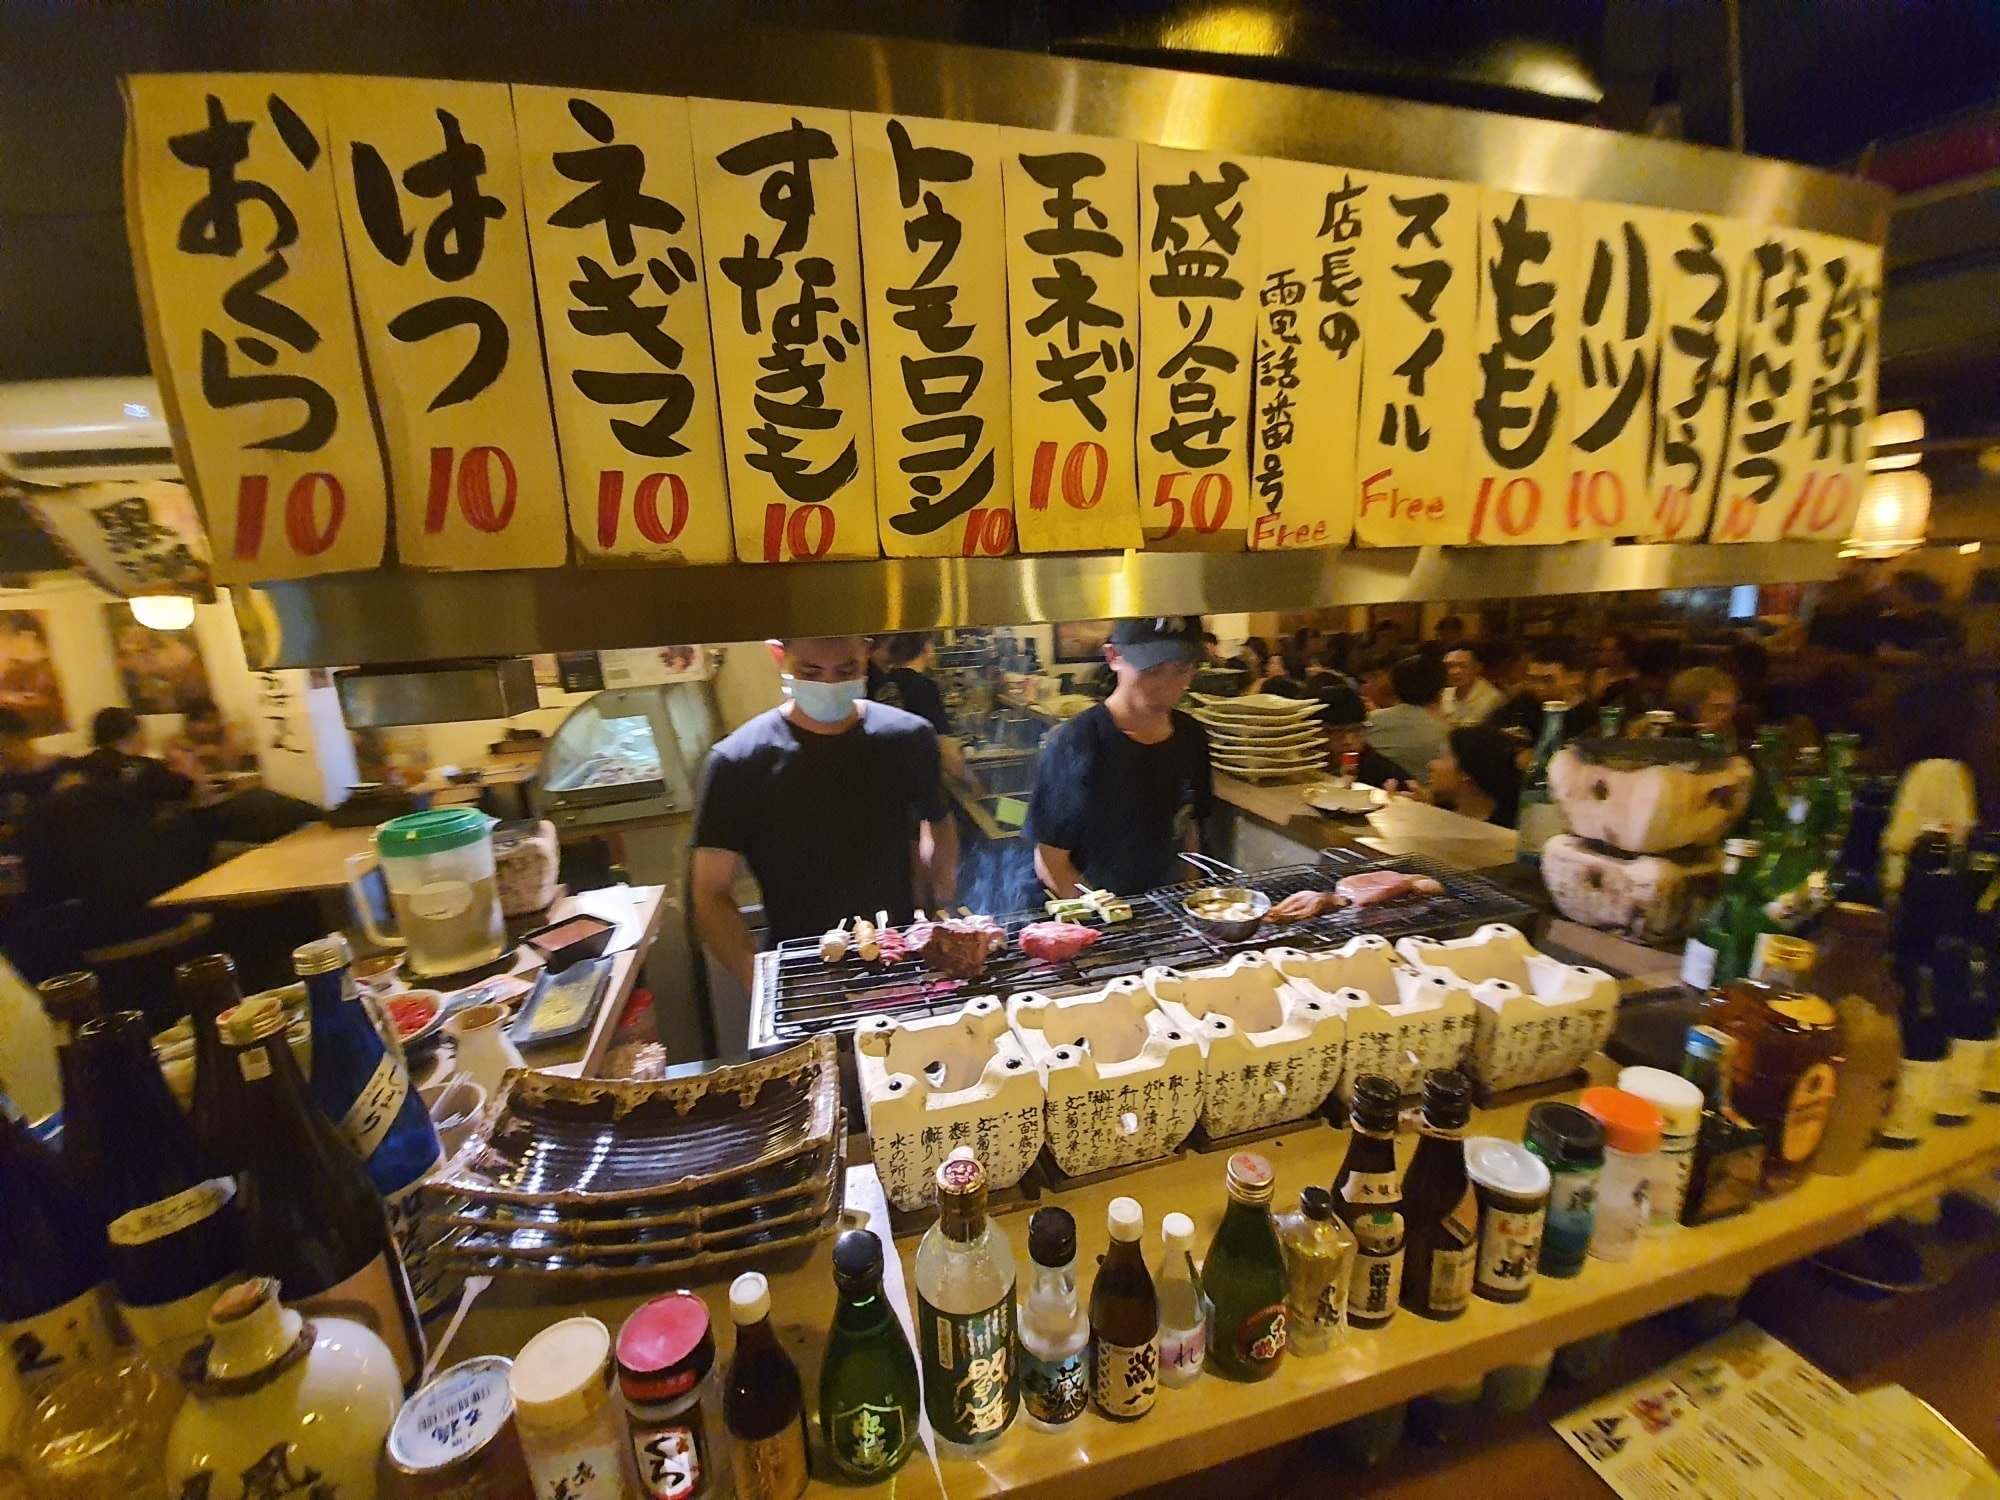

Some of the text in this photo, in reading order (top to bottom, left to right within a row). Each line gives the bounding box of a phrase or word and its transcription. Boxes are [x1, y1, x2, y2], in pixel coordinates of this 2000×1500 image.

[168, 93, 338, 452] おくら
[351, 108, 509, 413] はつ
[1018, 152, 1134, 432] 玉ネギ
[1312, 173, 1369, 359] 店長の
[716, 118, 860, 502] すなぎも
[1379, 192, 1452, 452] スマイル
[1473, 194, 1558, 470] もも
[1256, 267, 1306, 513] 電話番号
[231, 473, 345, 560] 10
[425, 447, 517, 534] 10
[597, 470, 688, 549] 10
[1029, 441, 1108, 511] 10
[1149, 472, 1232, 541] 50
[1360, 468, 1447, 522] Free
[1469, 477, 1542, 539] 10
[1566, 470, 1626, 530] 10
[1781, 471, 1850, 534] 10
[763, 503, 835, 561] 10
[962, 508, 1012, 556] 10
[1251, 511, 1329, 552] Free
